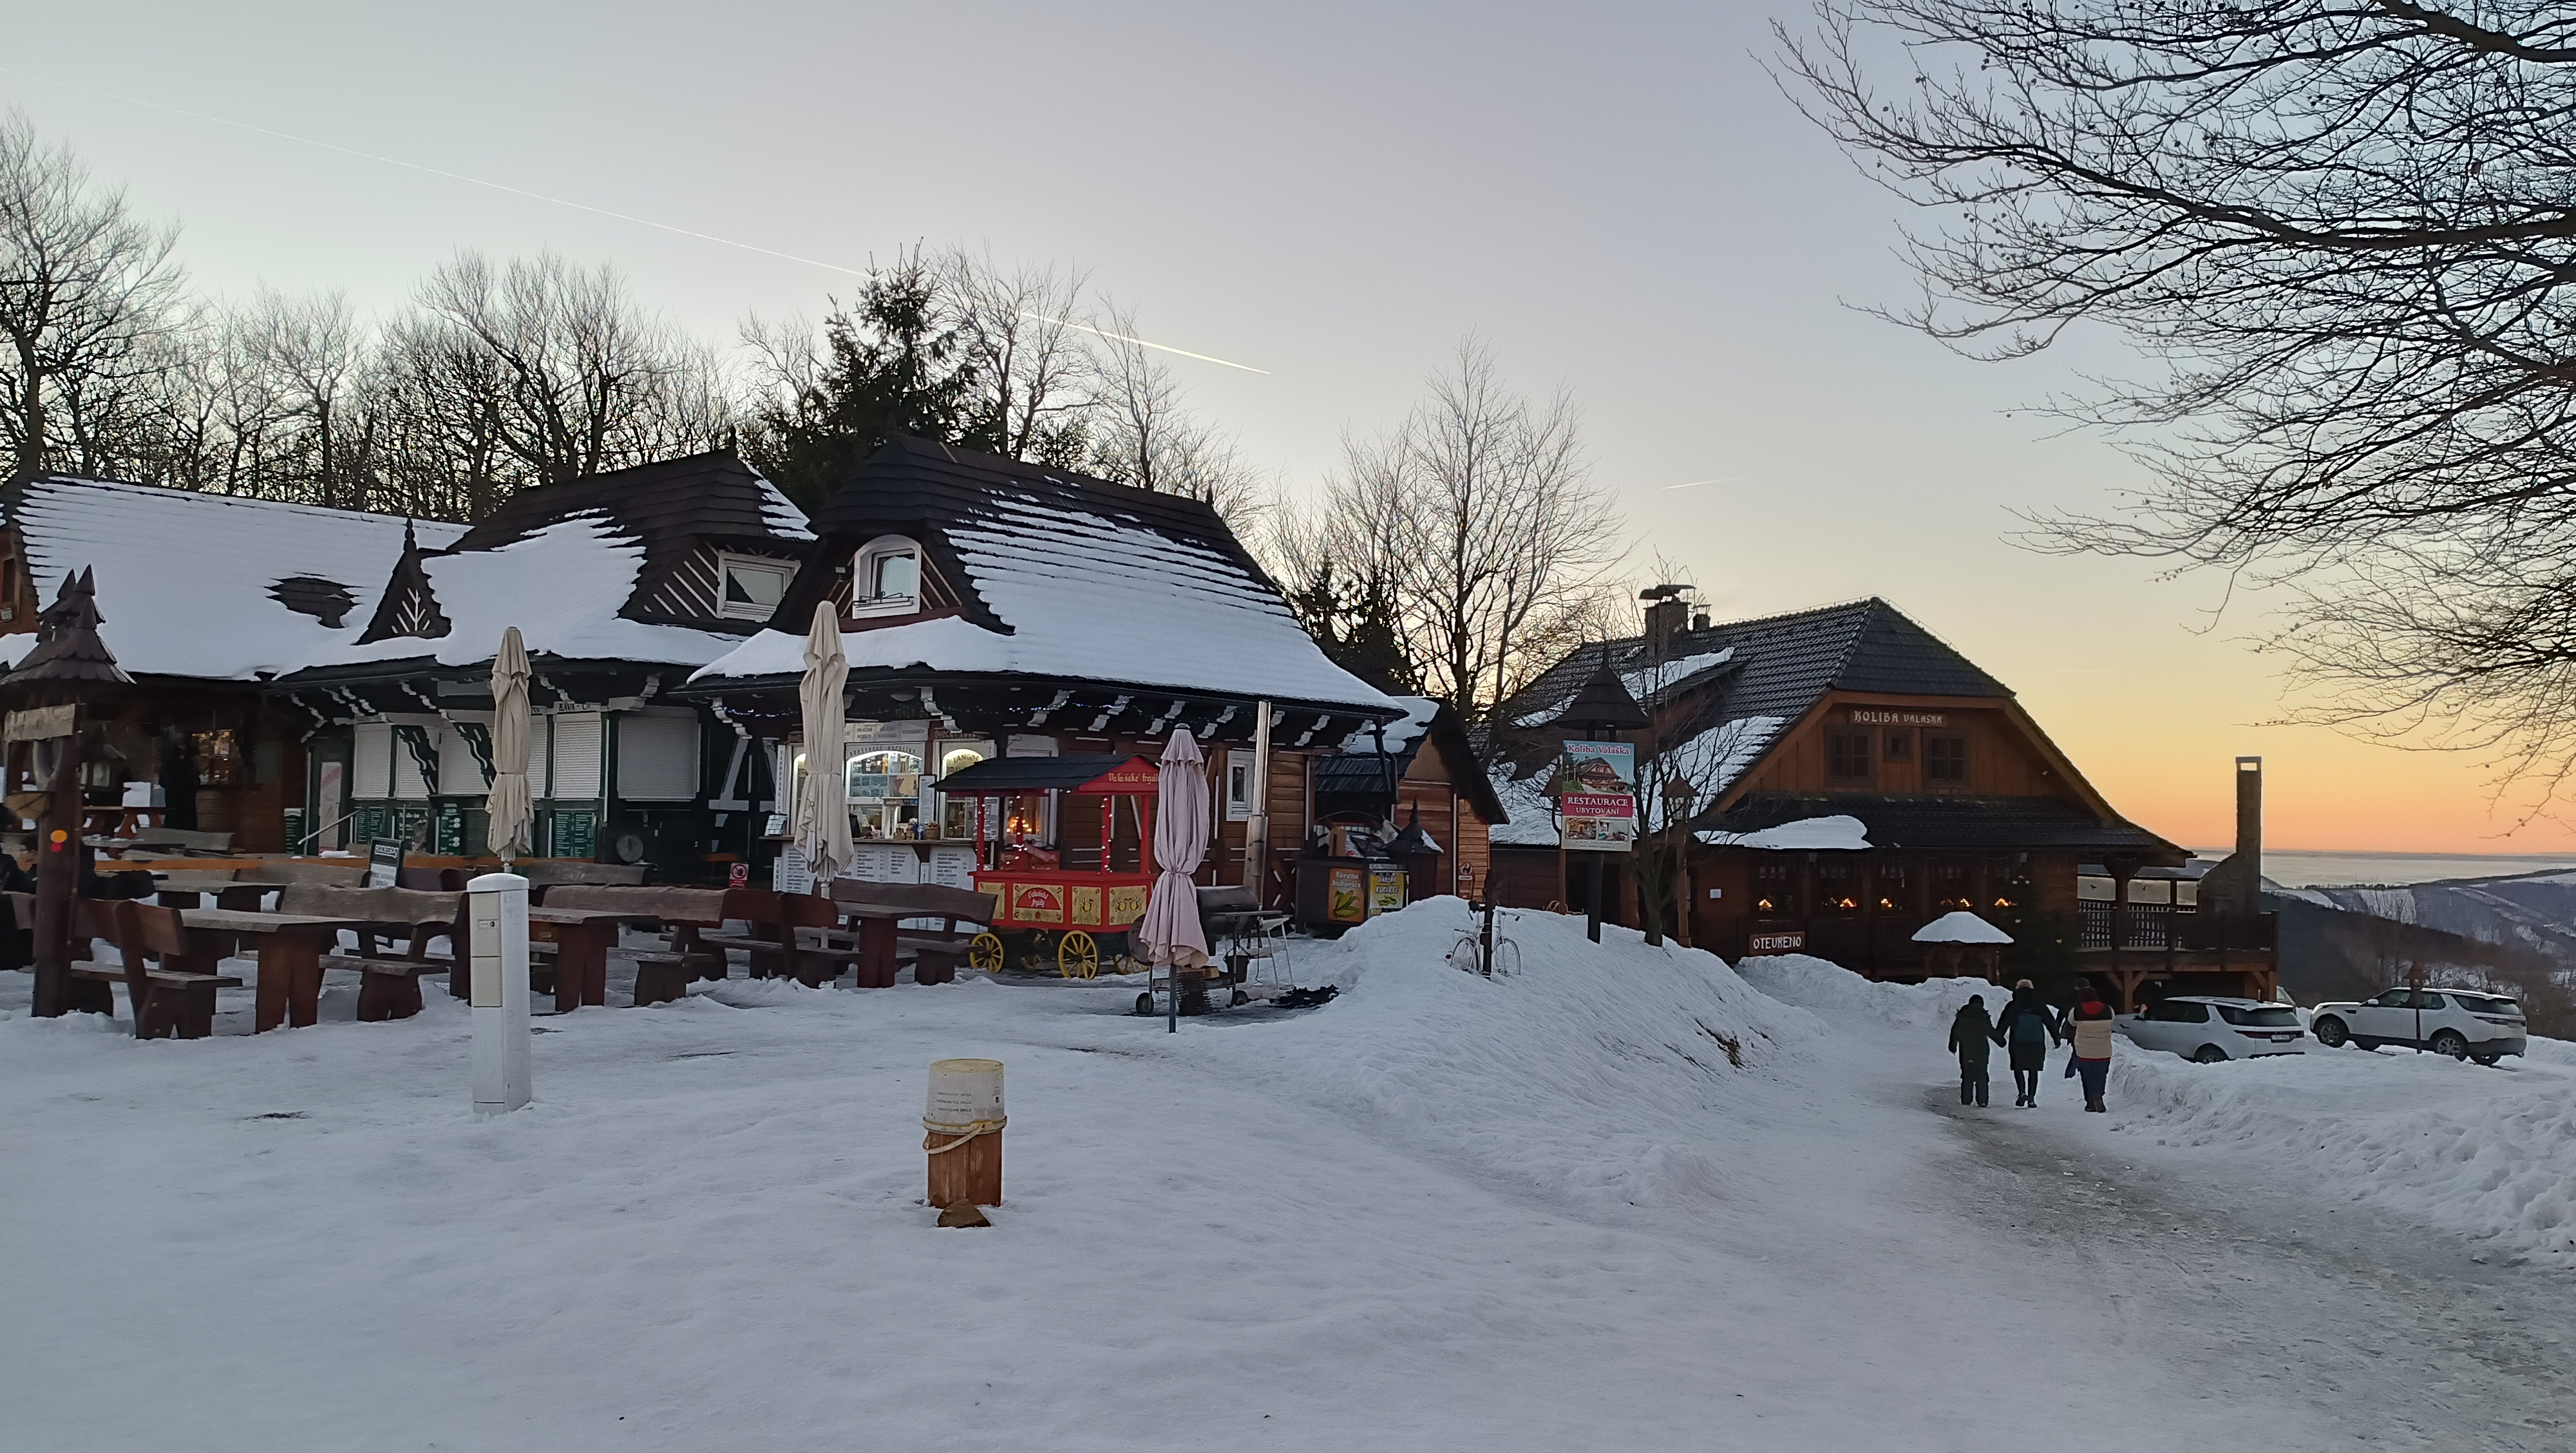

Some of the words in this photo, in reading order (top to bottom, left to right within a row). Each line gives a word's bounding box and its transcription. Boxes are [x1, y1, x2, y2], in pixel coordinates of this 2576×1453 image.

[1853, 710, 1899, 723] KOLIBA
[1567, 745, 1596, 753] Koliba
[1567, 797, 1629, 806] RESTAURACE
